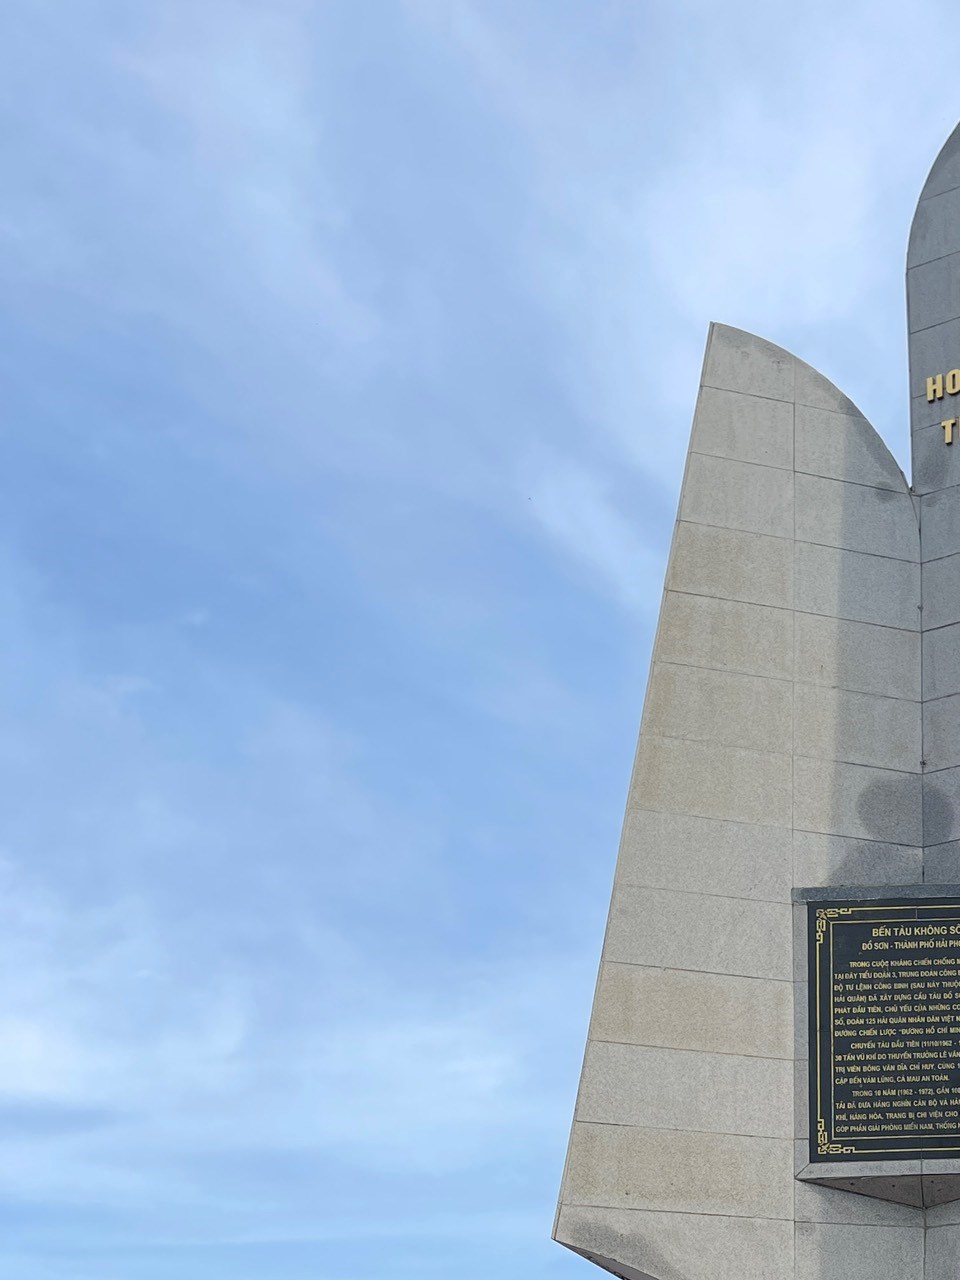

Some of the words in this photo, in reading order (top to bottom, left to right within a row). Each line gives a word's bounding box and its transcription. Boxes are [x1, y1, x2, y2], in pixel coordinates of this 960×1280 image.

[872, 925, 891, 936] BẾN
[894, 925, 912, 936] TÀU
[914, 924, 948, 936] KHÔNG
[894, 940, 918, 949] THÀNH
[920, 938, 934, 948] PHỐ
[936, 938, 948, 948] HẢI
[872, 960, 889, 968] CUỘC
[941, 1015, 954, 1023] VIỆT
